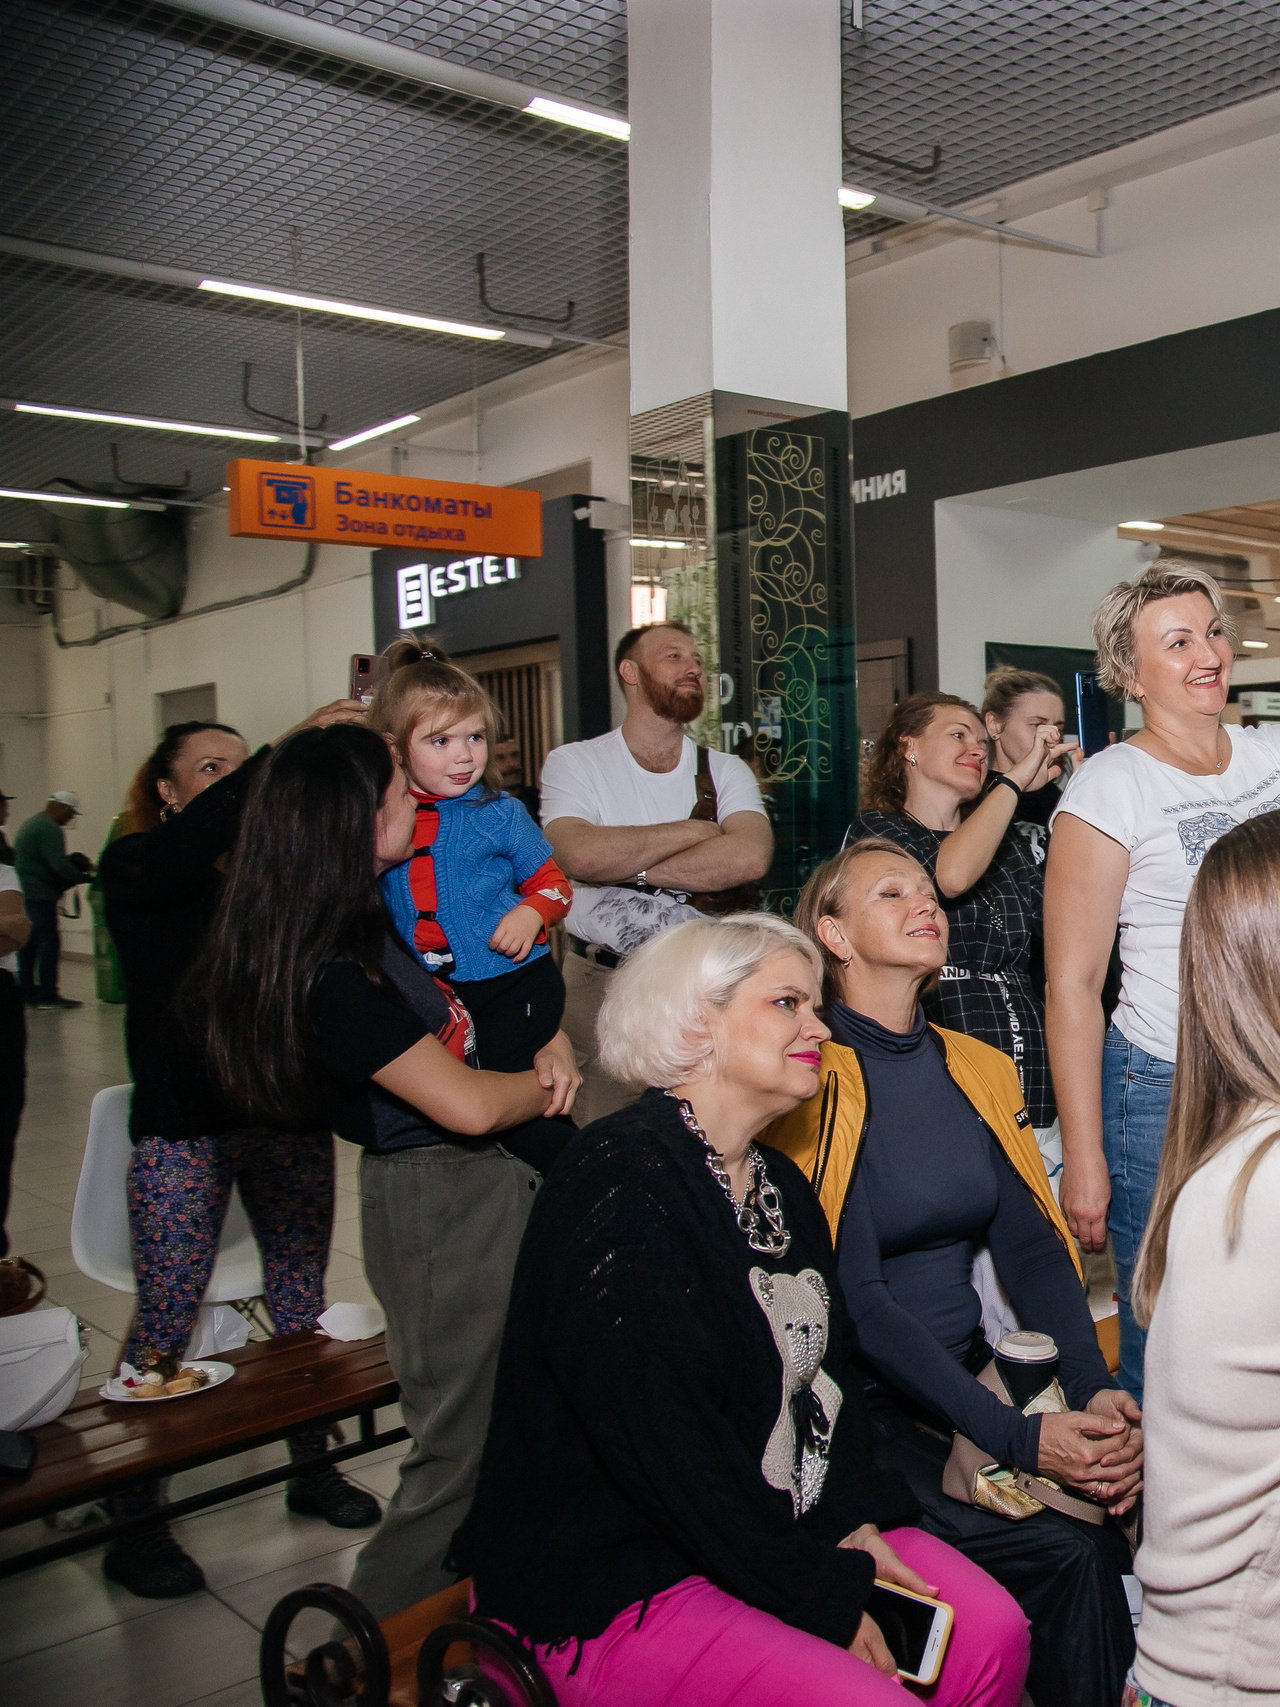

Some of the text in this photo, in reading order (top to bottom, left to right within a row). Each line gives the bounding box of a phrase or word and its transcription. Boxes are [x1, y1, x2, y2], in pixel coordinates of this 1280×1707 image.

[335, 481, 492, 518] Банкоматы
[336, 514, 466, 542] Зона отдыха
